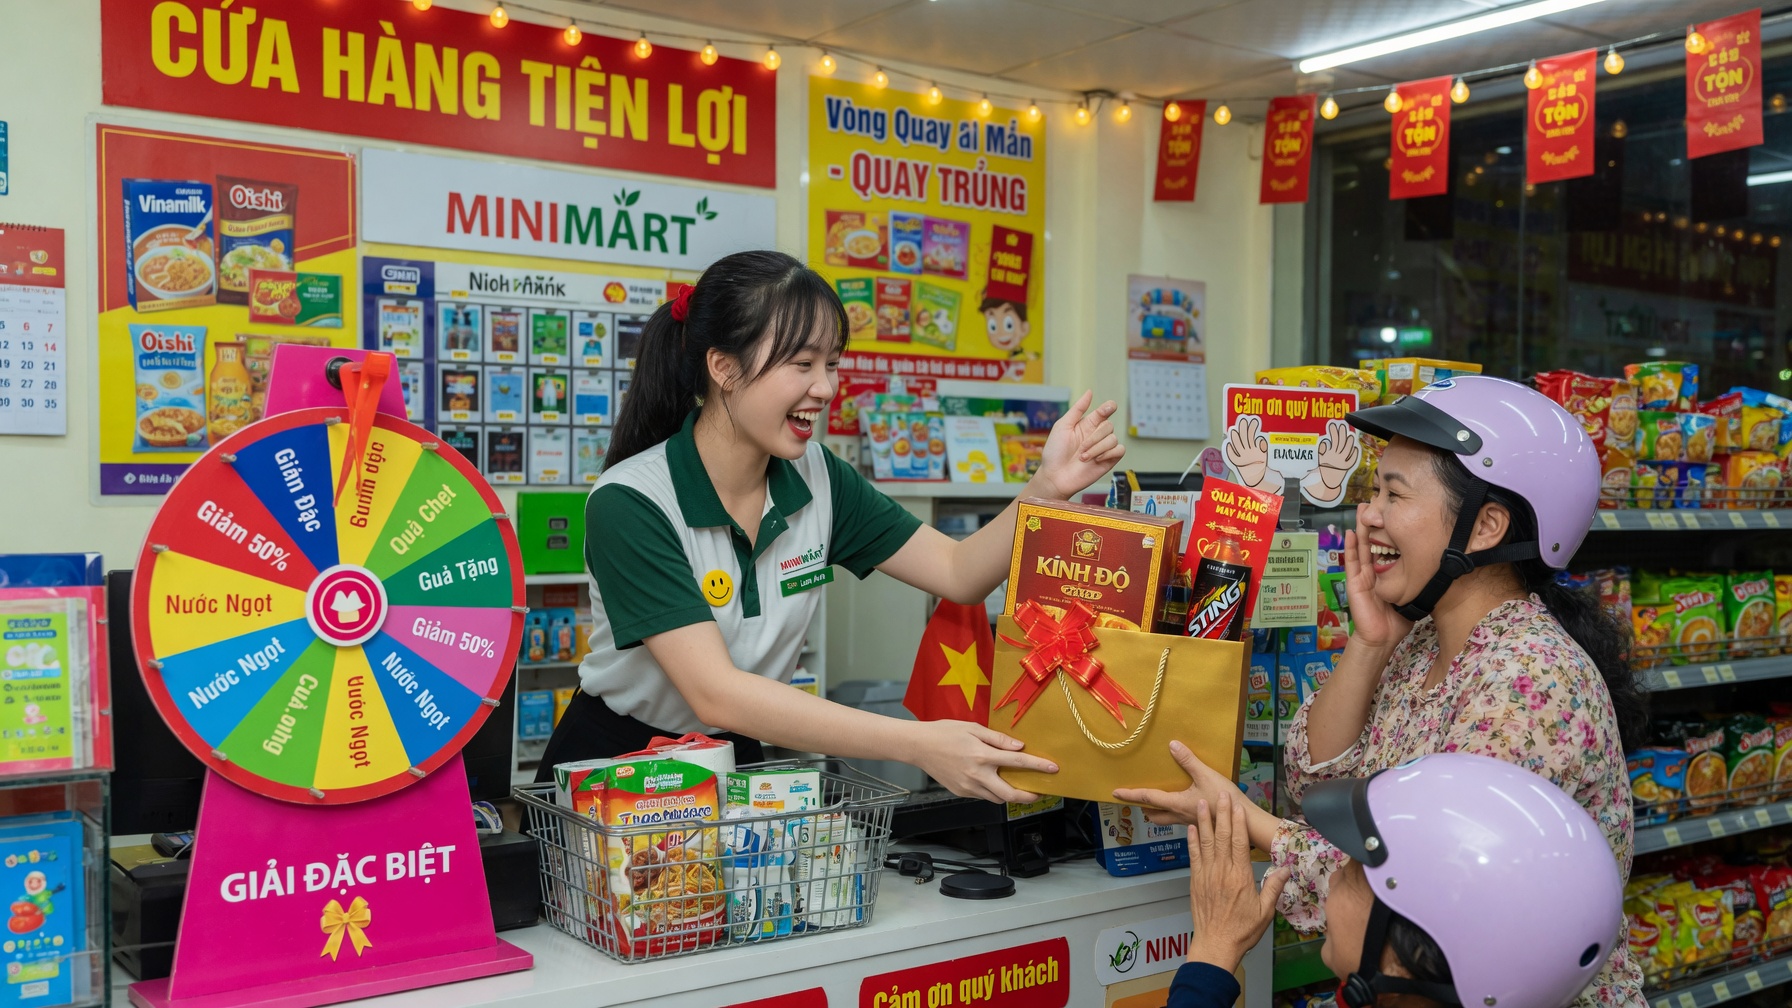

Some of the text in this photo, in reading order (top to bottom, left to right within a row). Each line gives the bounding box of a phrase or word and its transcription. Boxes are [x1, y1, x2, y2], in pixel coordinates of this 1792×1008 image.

[322, 20, 501, 121] HÀNG
[521, 55, 649, 149] TIỆN
[668, 83, 747, 165] LỢI
[825, 96, 887, 141] Vòng
[894, 108, 952, 149] Quay
[229, 184, 283, 211] Oishi
[852, 151, 930, 199] QUAY
[938, 159, 1026, 212] TRỦNG
[139, 194, 206, 214] Vinamilk
[446, 190, 697, 255] MINIMART
[23, 322, 30, 331] 6
[47, 323, 53, 333] 7
[141, 331, 197, 354] Oishi
[21, 341, 34, 350] 13
[44, 342, 57, 352] 14
[21, 360, 34, 370] 20
[44, 361, 56, 371] 21
[21, 379, 33, 389] 27
[1286, 396, 1309, 420] quý
[1311, 396, 1350, 419] khách
[197, 500, 291, 572] Giảm 50%
[455, 557, 499, 582] Tặng
[1094, 565, 1131, 593] ĐỘ
[166, 593, 273, 617] Nước Ngọt
[1188, 580, 1242, 638] STING
[412, 617, 496, 659] Giảm 50%
[187, 636, 286, 709] Nước Ngọt
[381, 651, 451, 731] Nước Ngọt
[349, 725, 371, 769] Ngọt
[220, 842, 456, 903] GIẢI ĐẶC BIỆT
[1146, 931, 1194, 964] NINI
[873, 956, 1059, 1008] Cảm ơn quý khách
